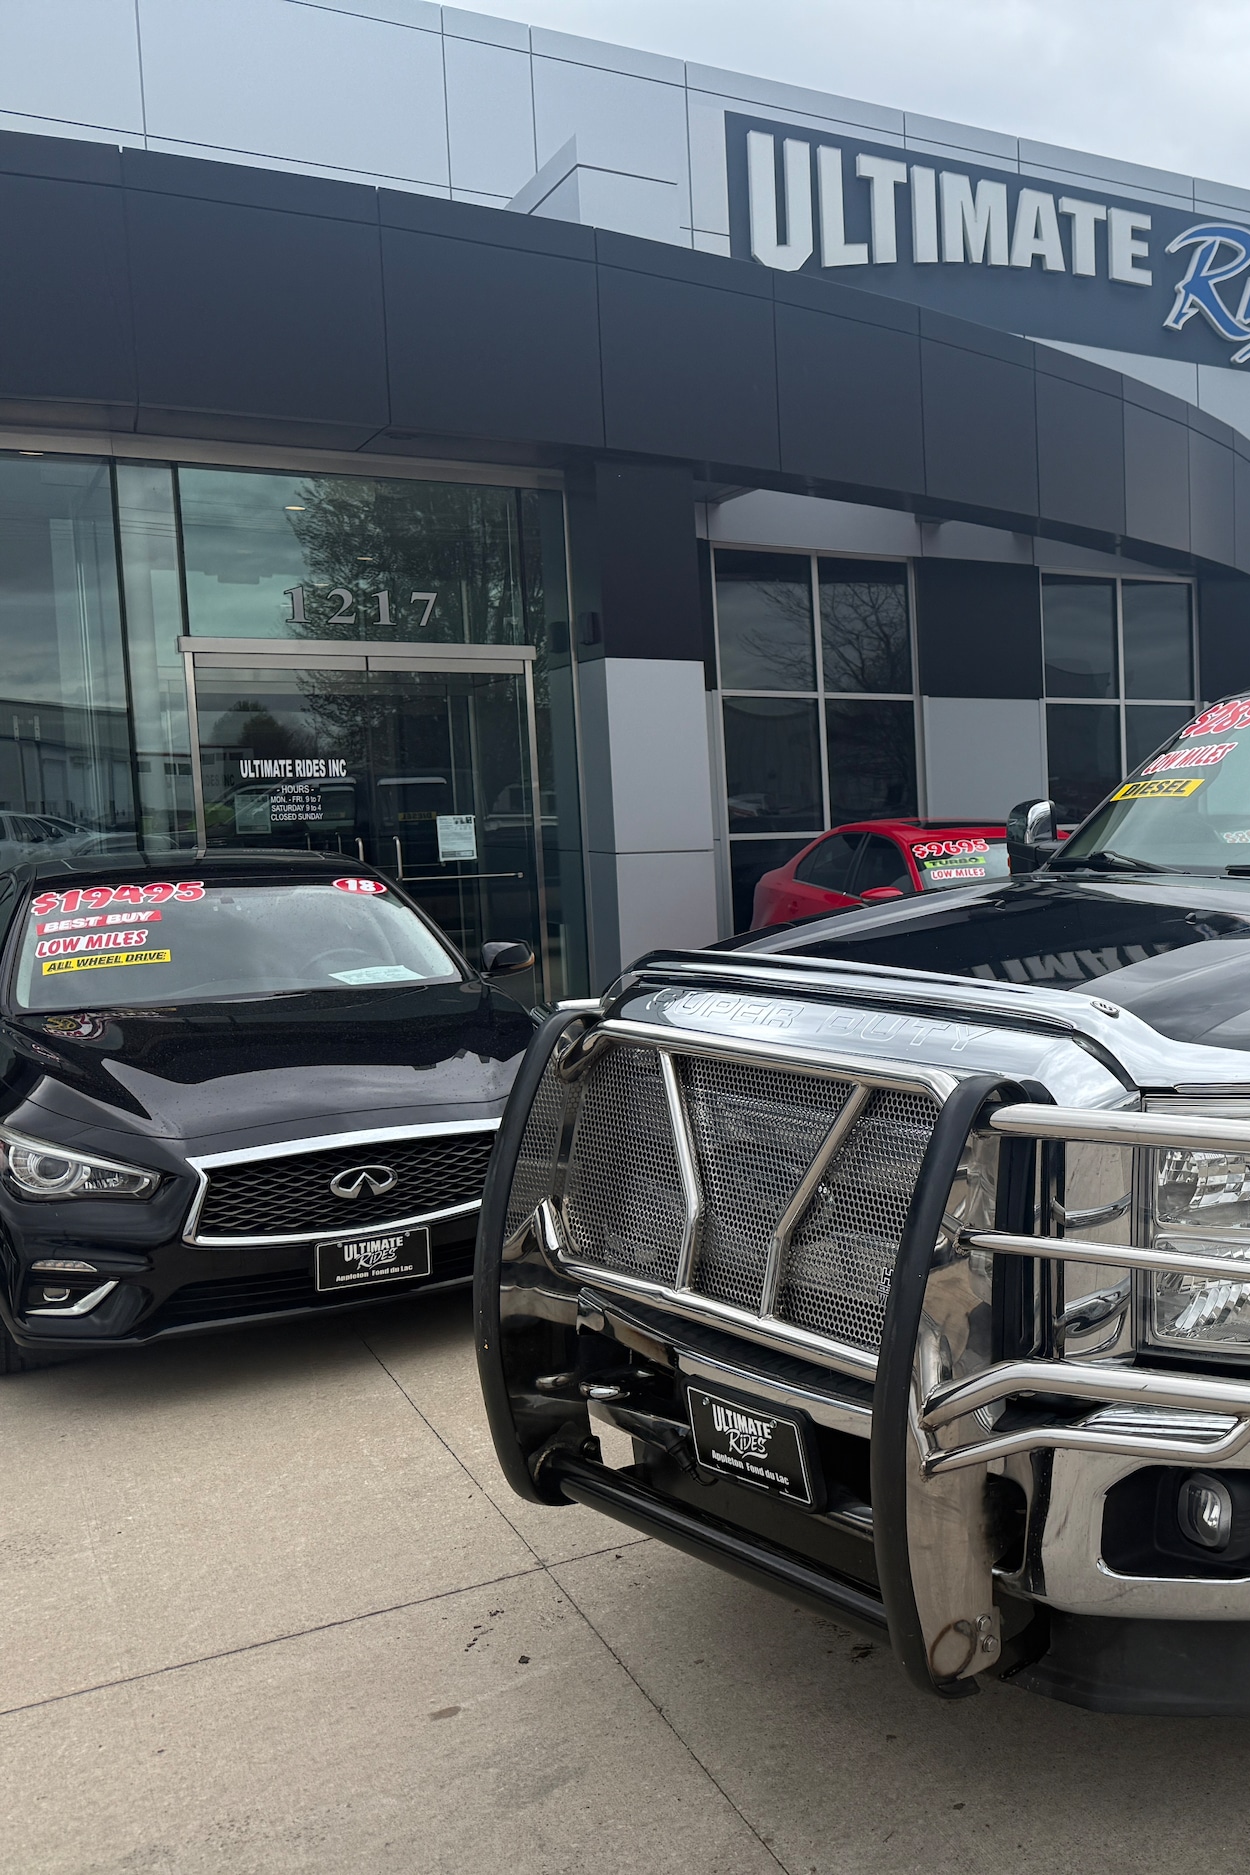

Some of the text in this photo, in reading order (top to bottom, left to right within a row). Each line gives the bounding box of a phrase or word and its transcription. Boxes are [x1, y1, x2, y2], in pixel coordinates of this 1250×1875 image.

[747, 130, 1153, 287] ULTIMATE
[284, 586, 437, 627] 1217
[240, 759, 347, 778] ULTIMATE RIDES INC
[1141, 742, 1238, 776] LOW MILES
[282, 785, 310, 793] HOURS
[1120, 780, 1192, 797] DIESEL
[271, 813, 297, 821] CLOSED
[912, 838, 989, 858] $9695
[929, 857, 979, 867] TURBO
[931, 868, 985, 880] LOW MILES
[345, 879, 376, 892] 18
[31, 881, 206, 916] $19495
[43, 911, 154, 933] BEST BUY
[36, 930, 148, 958] LOW MILES
[47, 951, 166, 972] ALL WHEEL DRIVE
[646, 988, 996, 1051] SUPER DUTY
[344, 1236, 403, 1262] ULTIMATE
[336, 1271, 369, 1282] Appleton
[372, 1268, 389, 1277] Fond
[390, 1266, 399, 1274] du
[712, 1404, 772, 1439] ULTIMATE
[712, 1450, 789, 1485] Appleton Fond du Lac
